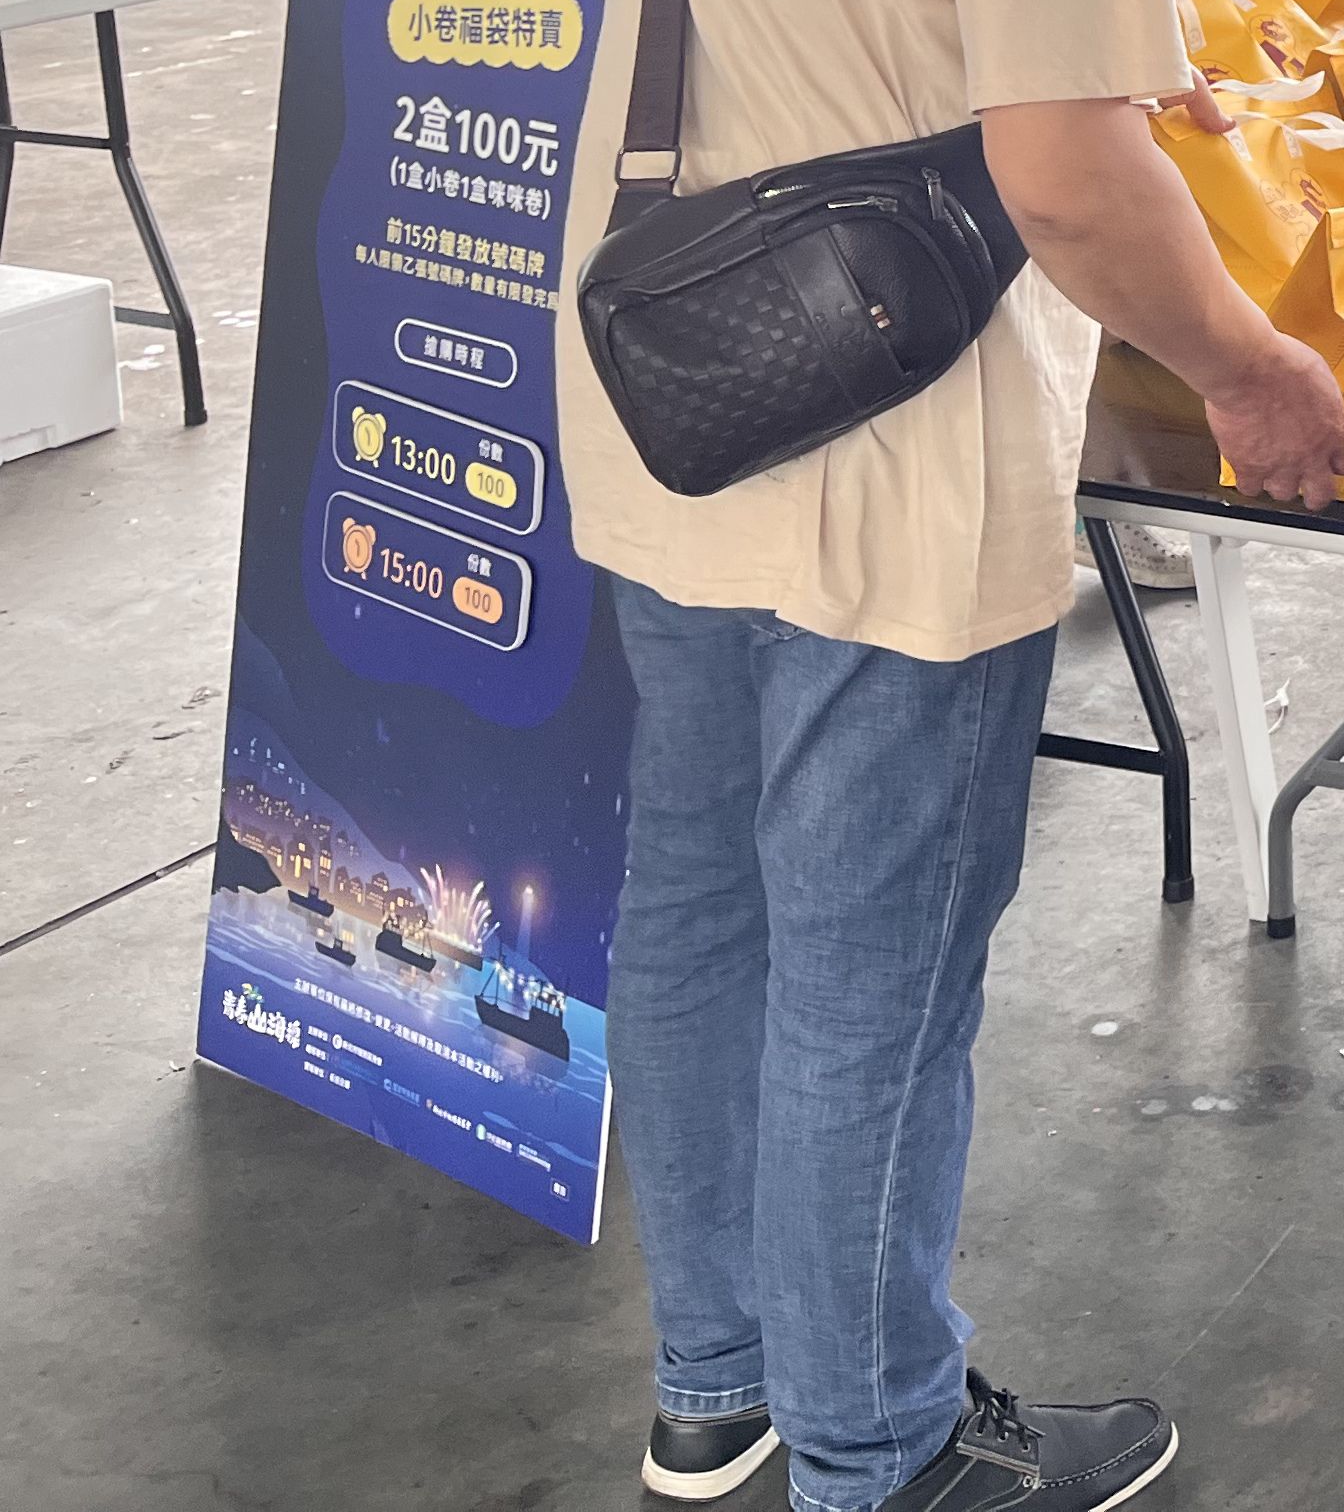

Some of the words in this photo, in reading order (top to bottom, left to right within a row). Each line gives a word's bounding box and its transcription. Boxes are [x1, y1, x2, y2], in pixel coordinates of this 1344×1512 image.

[408, 4, 563, 50] 小卷福袋特賣
[393, 95, 560, 177] 2盒100元
[386, 217, 545, 279] 前15分鐘發放號碼牌
[391, 435, 456, 485] 13:00
[476, 471, 505, 499] 100
[380, 548, 443, 598] 15:00
[464, 588, 492, 614] 100
